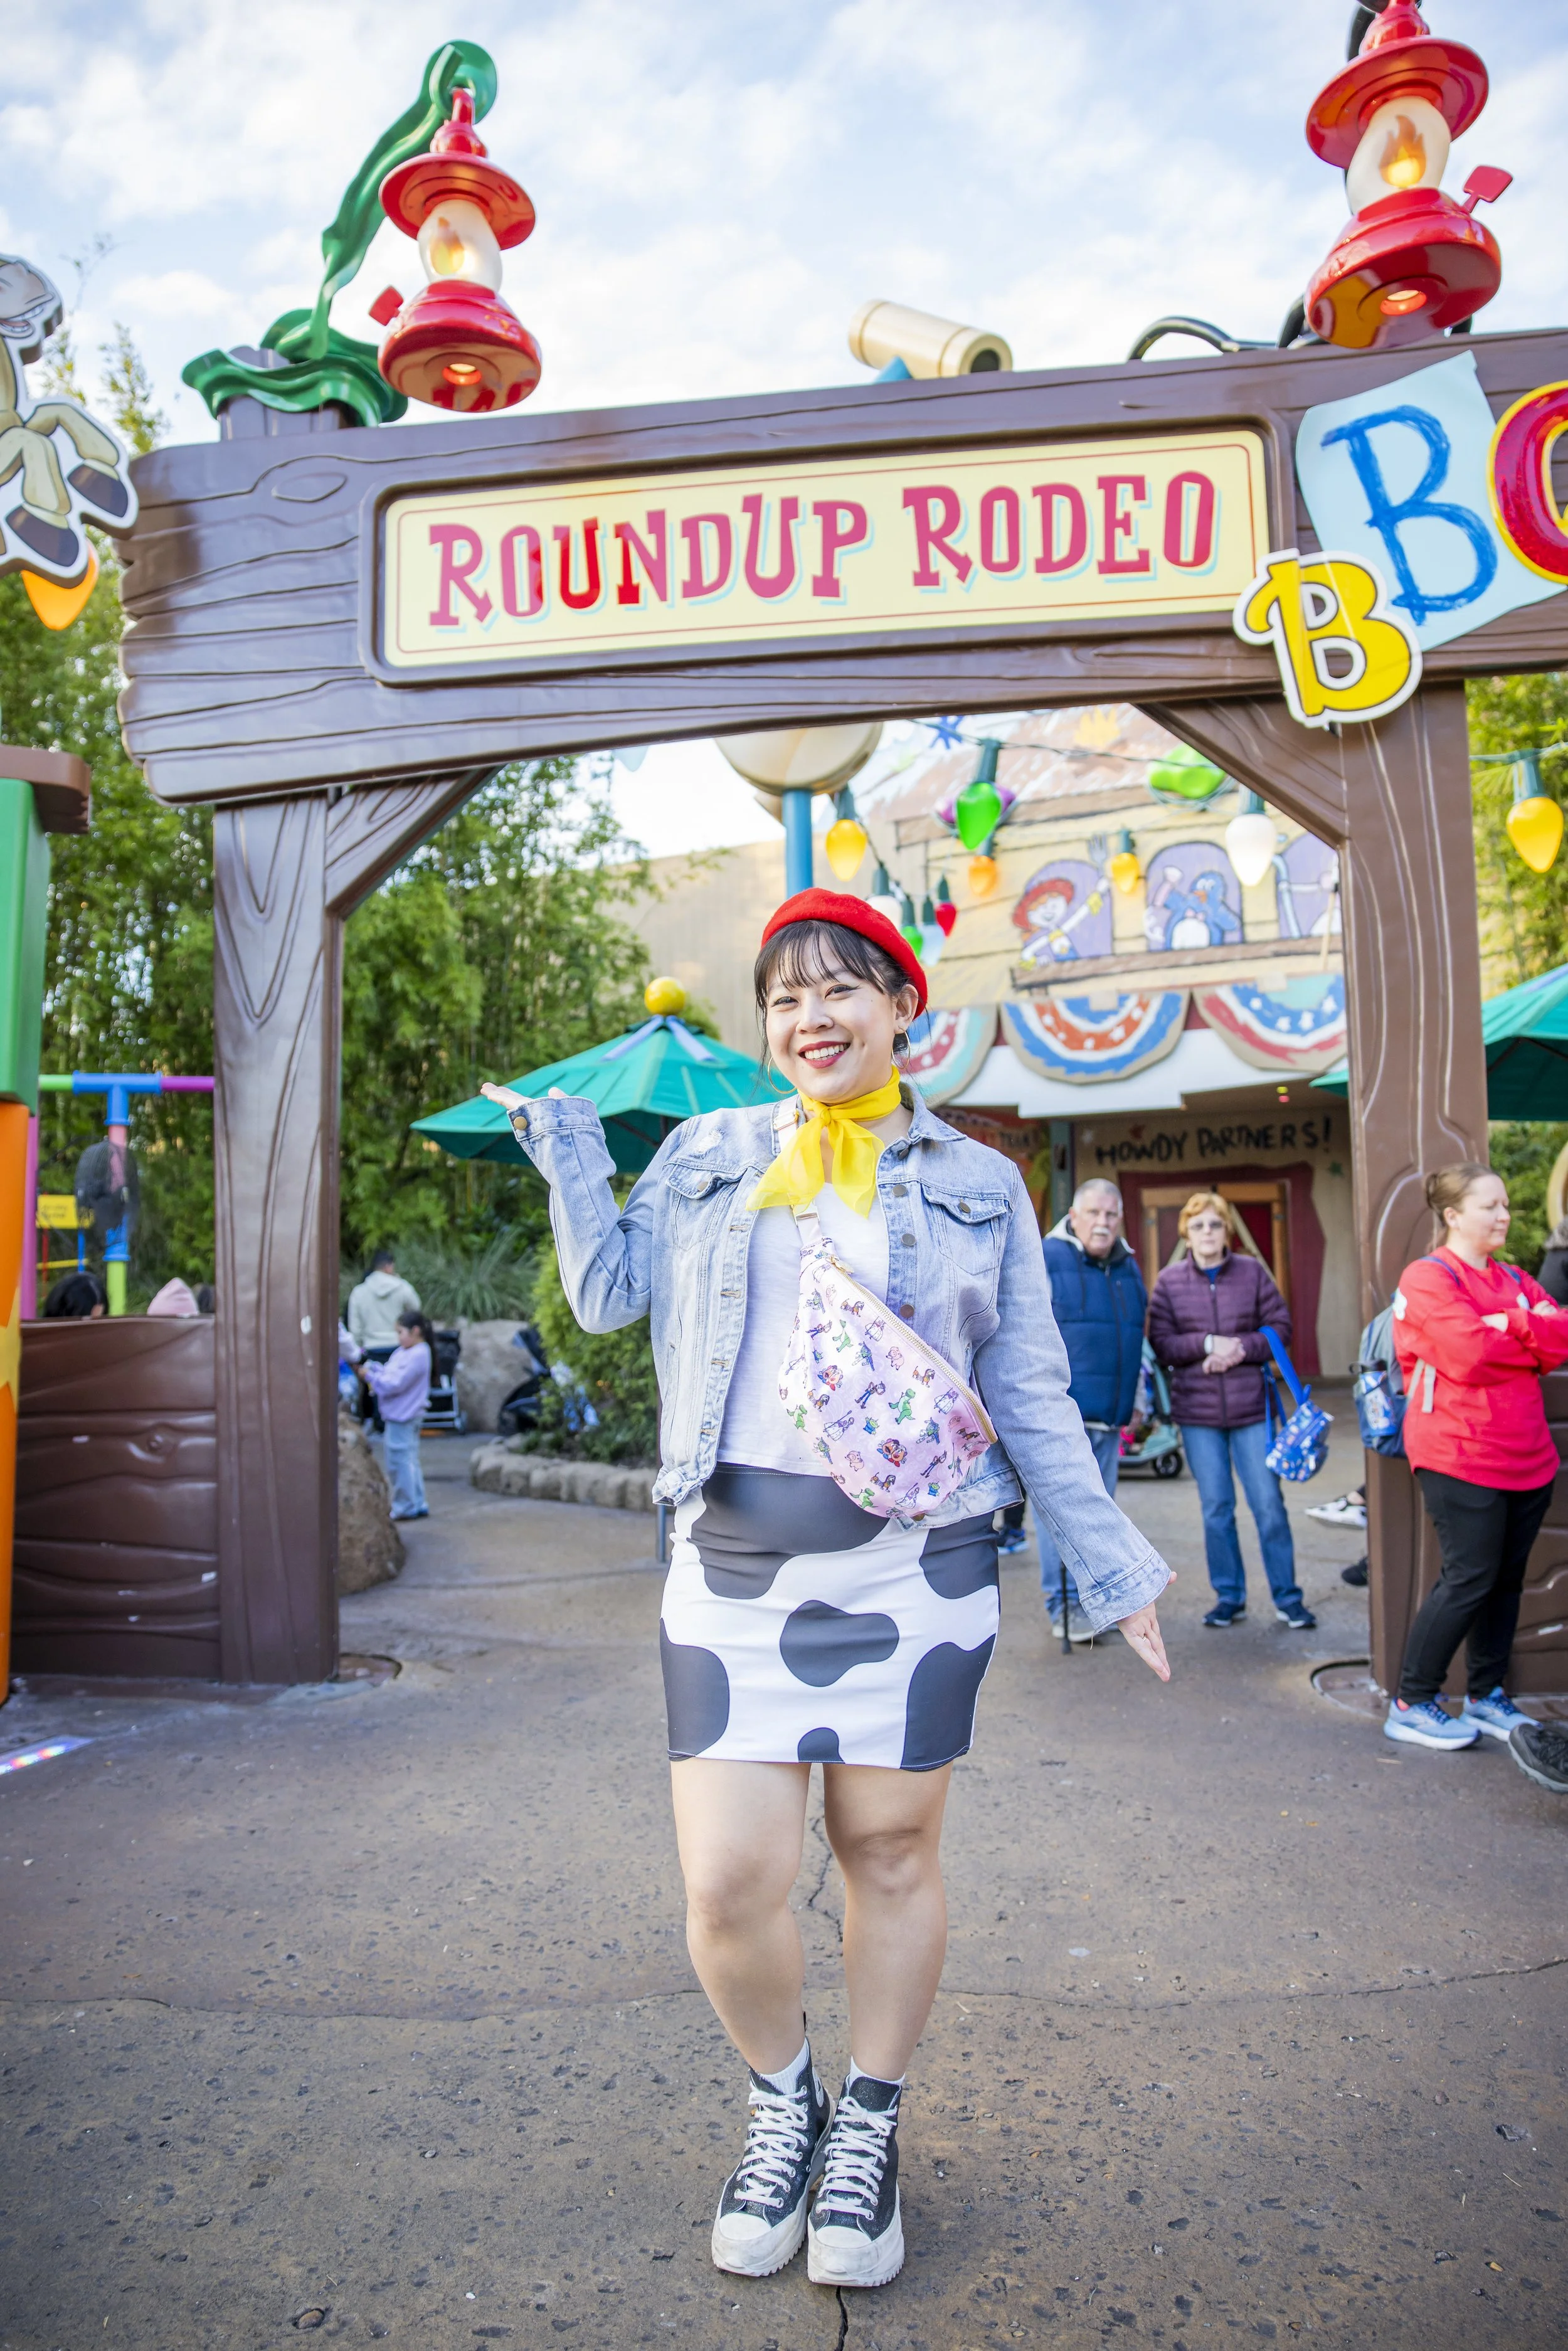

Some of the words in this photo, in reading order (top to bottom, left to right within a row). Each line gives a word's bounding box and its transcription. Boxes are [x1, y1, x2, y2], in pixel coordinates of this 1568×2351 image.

[428, 493, 871, 629] ROUNDUP
[902, 470, 1217, 590] RODEO
[1095, 1130, 1187, 1165] HOWDY
[1196, 1116, 1331, 1159] PARTNERS!
